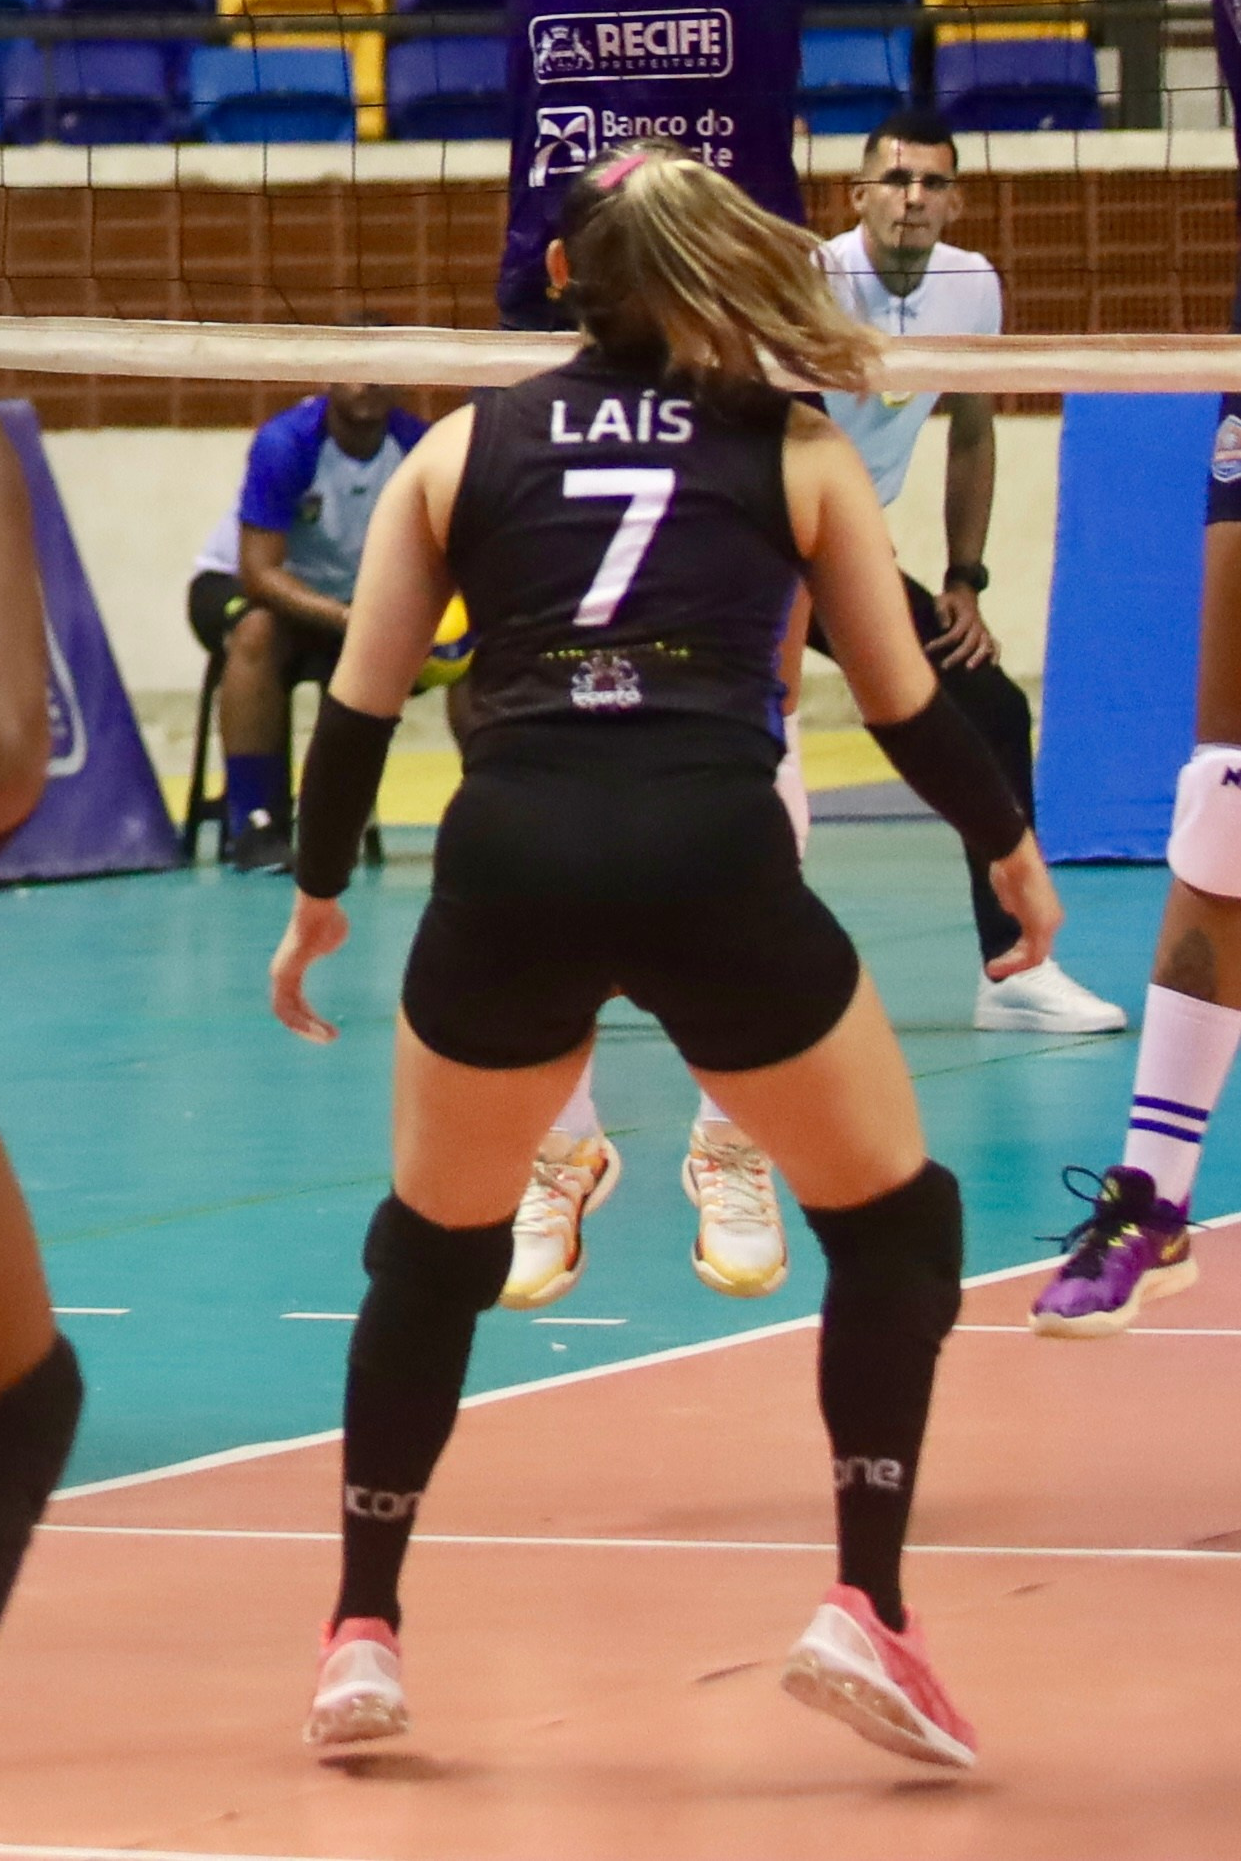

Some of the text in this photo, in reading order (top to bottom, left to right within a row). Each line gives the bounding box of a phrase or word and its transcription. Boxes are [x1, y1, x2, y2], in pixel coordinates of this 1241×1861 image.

[595, 18, 722, 58] RECIFE
[599, 57, 722, 70] PREFEITURA
[601, 108, 735, 138] Banco do
[550, 388, 694, 444] LAÍS
[562, 468, 677, 627] 7
